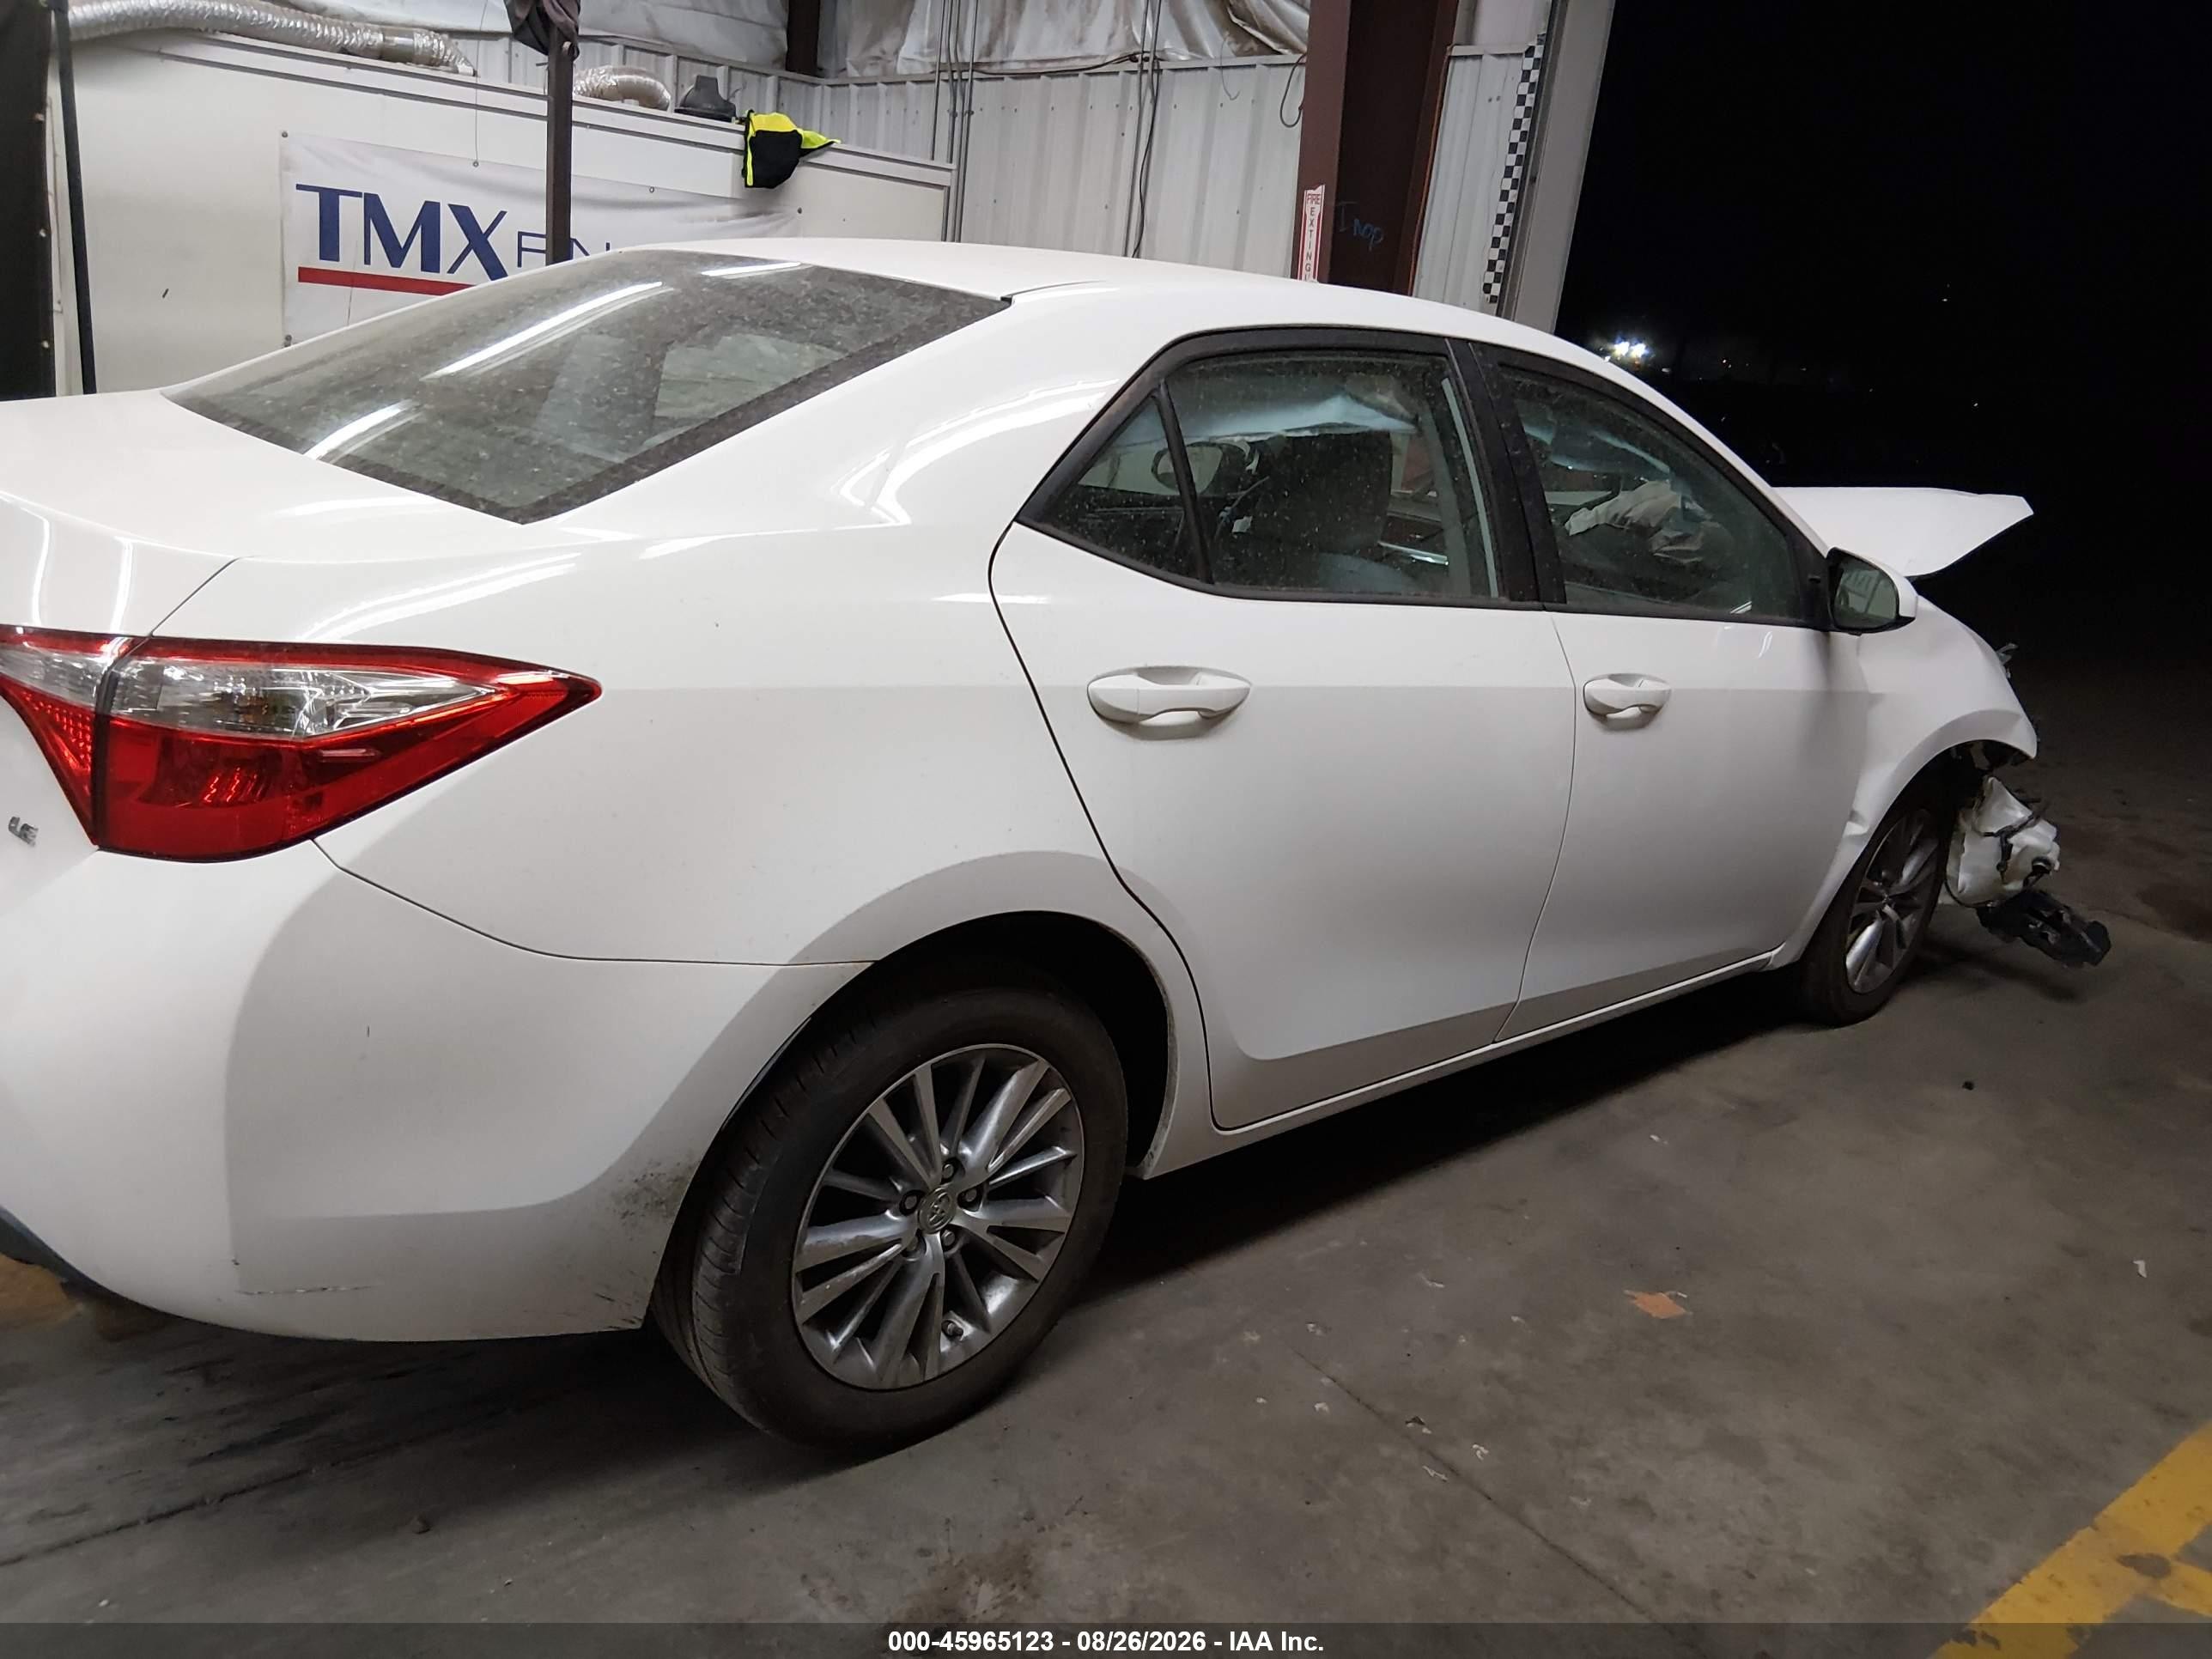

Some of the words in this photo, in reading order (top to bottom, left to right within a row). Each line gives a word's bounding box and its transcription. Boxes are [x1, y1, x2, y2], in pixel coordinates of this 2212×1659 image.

[1306, 192, 1322, 205] FIRE
[295, 183, 508, 282] TMX
[8, 816, 40, 848] LE
